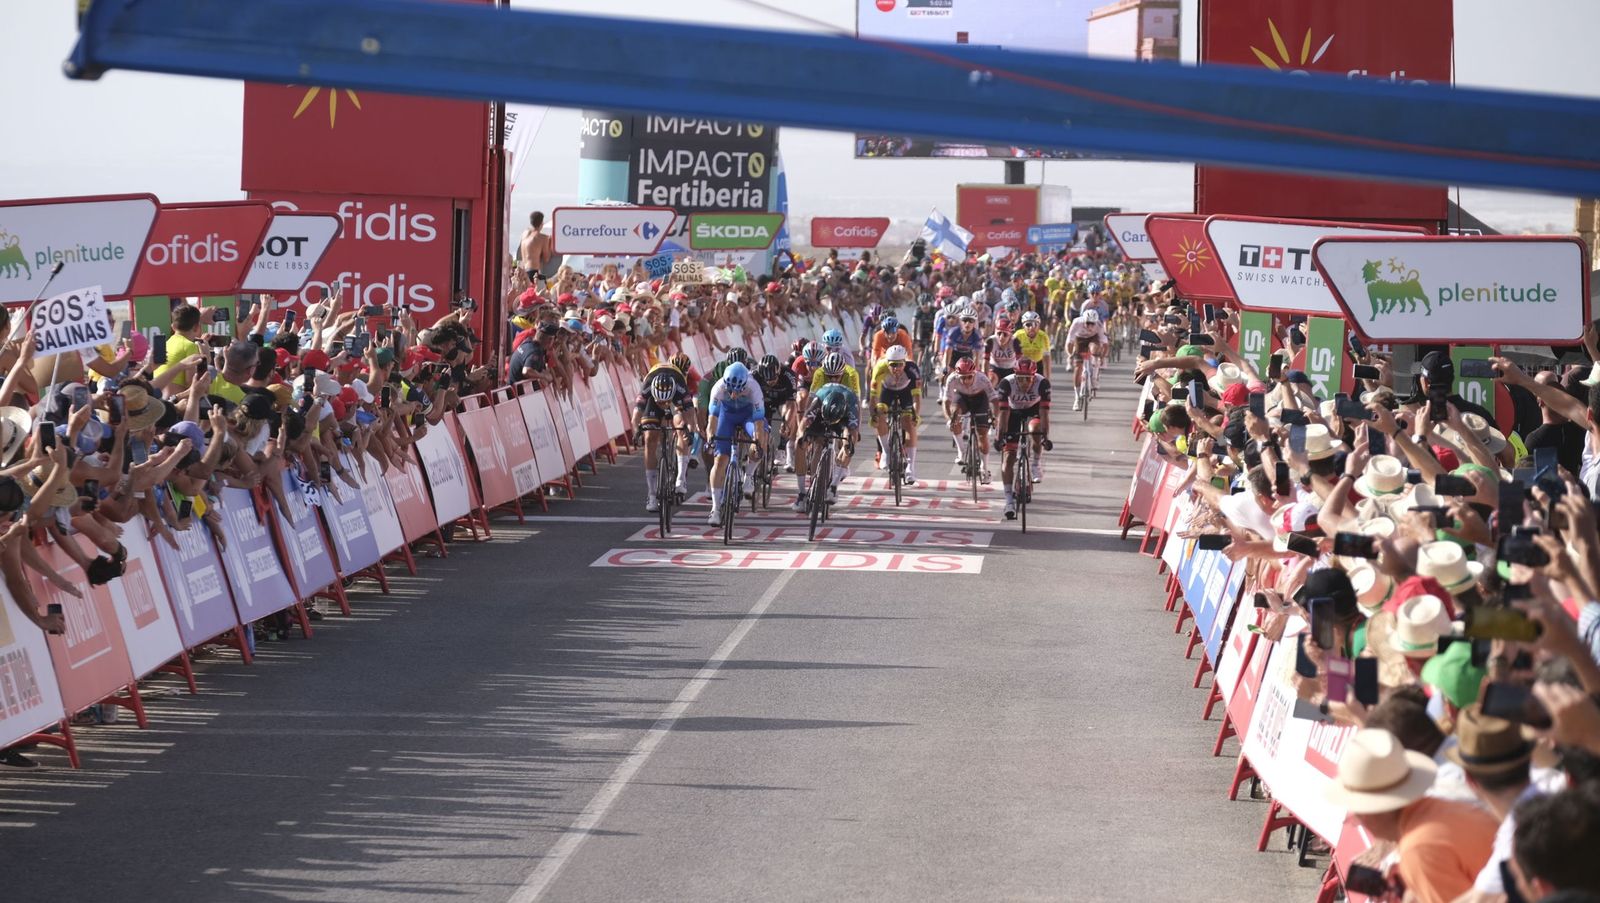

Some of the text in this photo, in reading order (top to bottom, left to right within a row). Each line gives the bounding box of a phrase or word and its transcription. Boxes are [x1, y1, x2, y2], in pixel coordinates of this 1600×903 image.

[637, 179, 763, 208] Fertiberia
[562, 224, 628, 237] Carrefour
[696, 222, 769, 238] ŠKODA
[833, 226, 878, 238] Cofidis
[35, 241, 125, 270] plenitude
[146, 233, 239, 266] ofidis
[255, 261, 309, 270] INCE 1853
[674, 263, 696, 274] SOS
[1237, 271, 1274, 283] SWISS
[1438, 283, 1557, 306] plenitude
[34, 295, 83, 330] SOS
[34, 320, 108, 352] SALINAS
[643, 526, 974, 546] COFIDIS
[607, 549, 963, 572] COFIDIS
